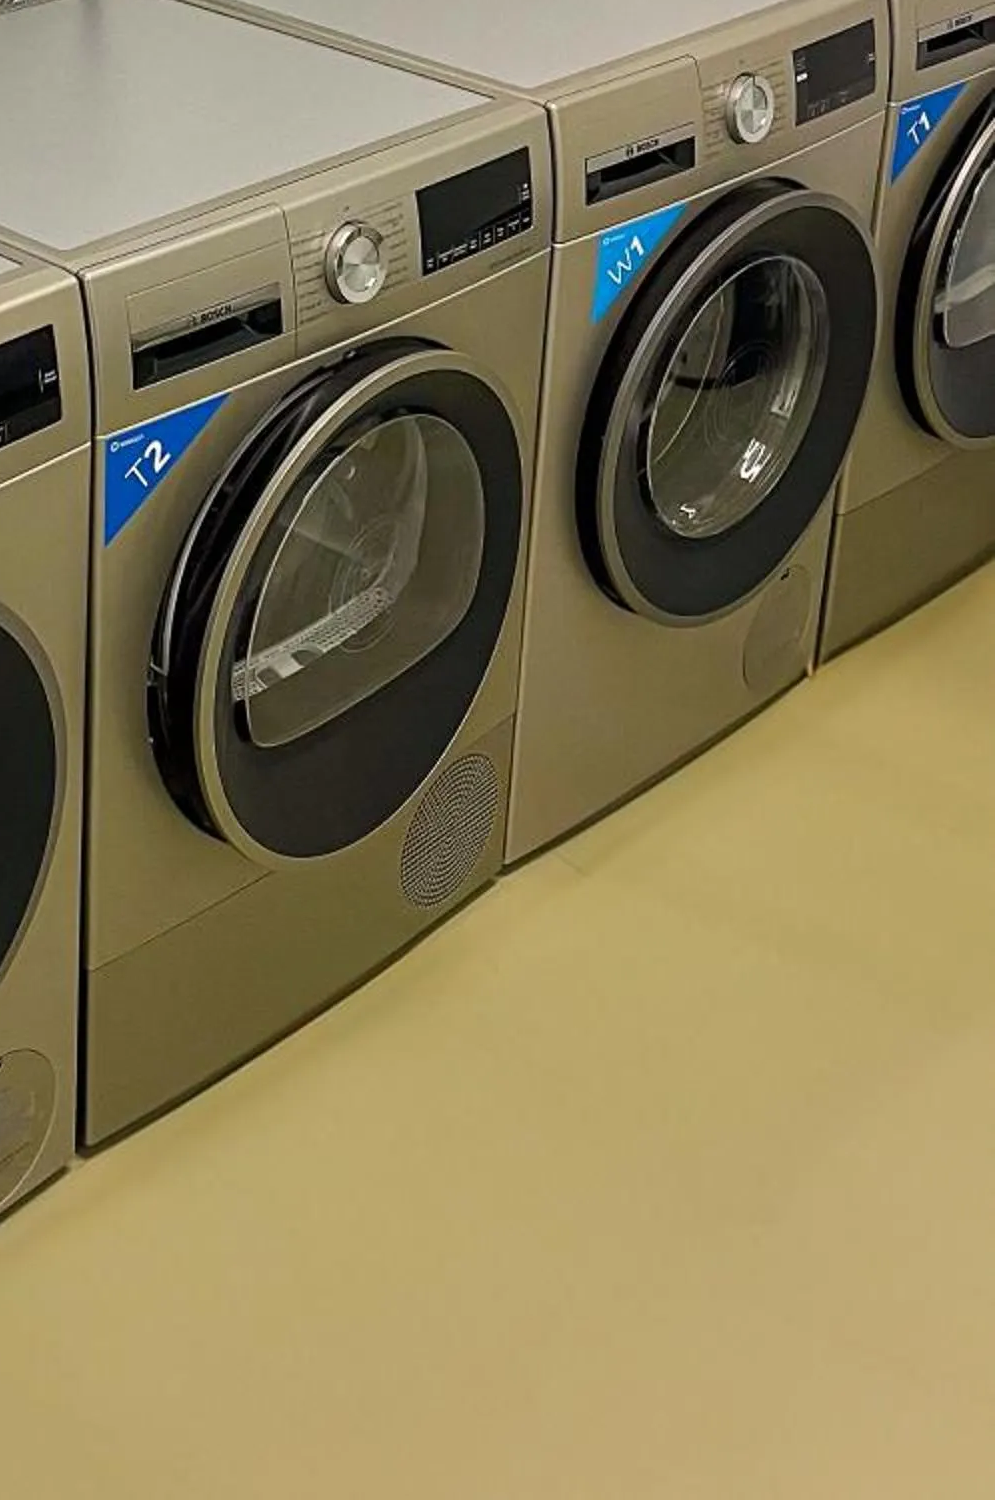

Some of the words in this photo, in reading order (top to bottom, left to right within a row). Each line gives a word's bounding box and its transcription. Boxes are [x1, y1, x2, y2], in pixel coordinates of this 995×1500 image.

[906, 111, 931, 146] T1
[606, 235, 645, 285] W1
[200, 303, 233, 324] BOSCH
[124, 439, 173, 488] T2
